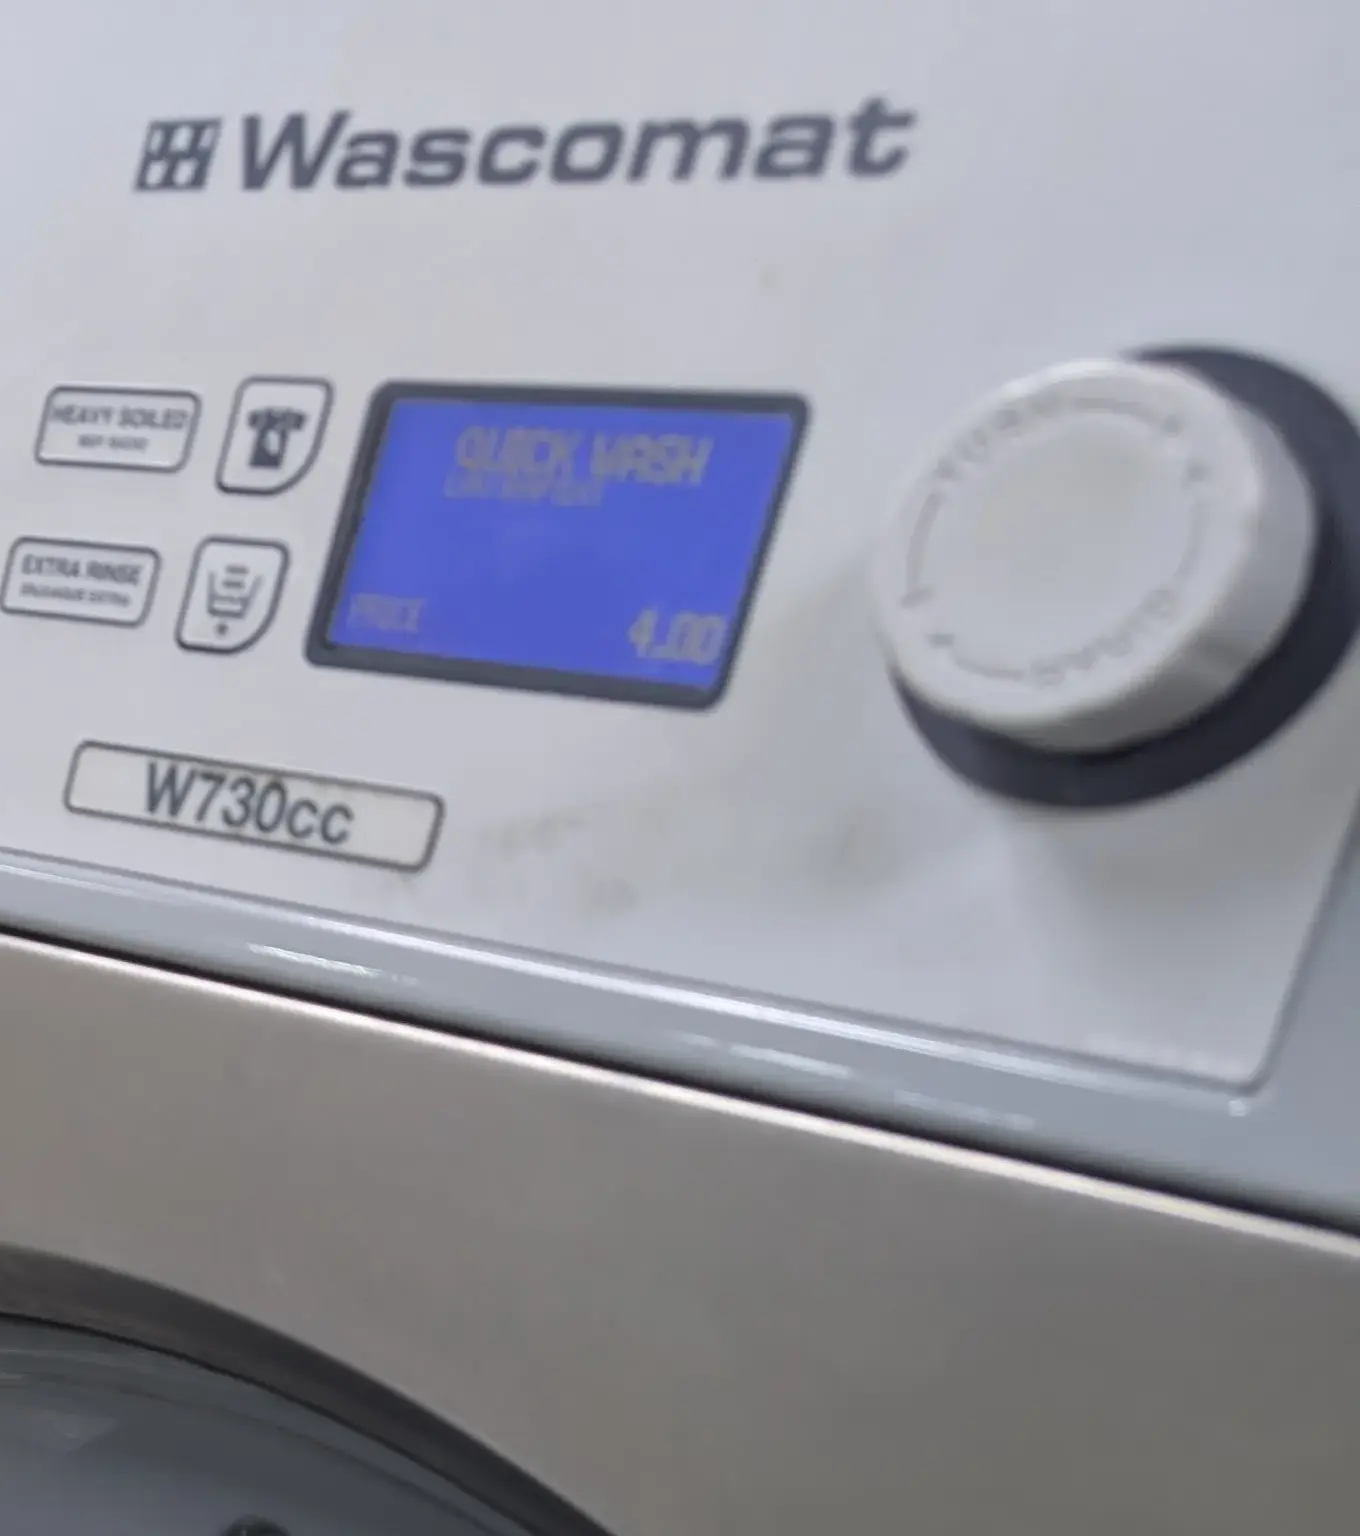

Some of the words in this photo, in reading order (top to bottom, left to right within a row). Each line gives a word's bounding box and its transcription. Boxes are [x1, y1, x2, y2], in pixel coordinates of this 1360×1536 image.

[240, 94, 917, 192] Wascomat
[50, 403, 114, 426] HEAVY
[456, 425, 584, 478] QUICK
[590, 433, 714, 487] WASH
[20, 553, 80, 577] EXTRA
[86, 560, 144, 586] RINSE
[628, 605, 728, 666] 4.00
[144, 759, 355, 846] W730cc
